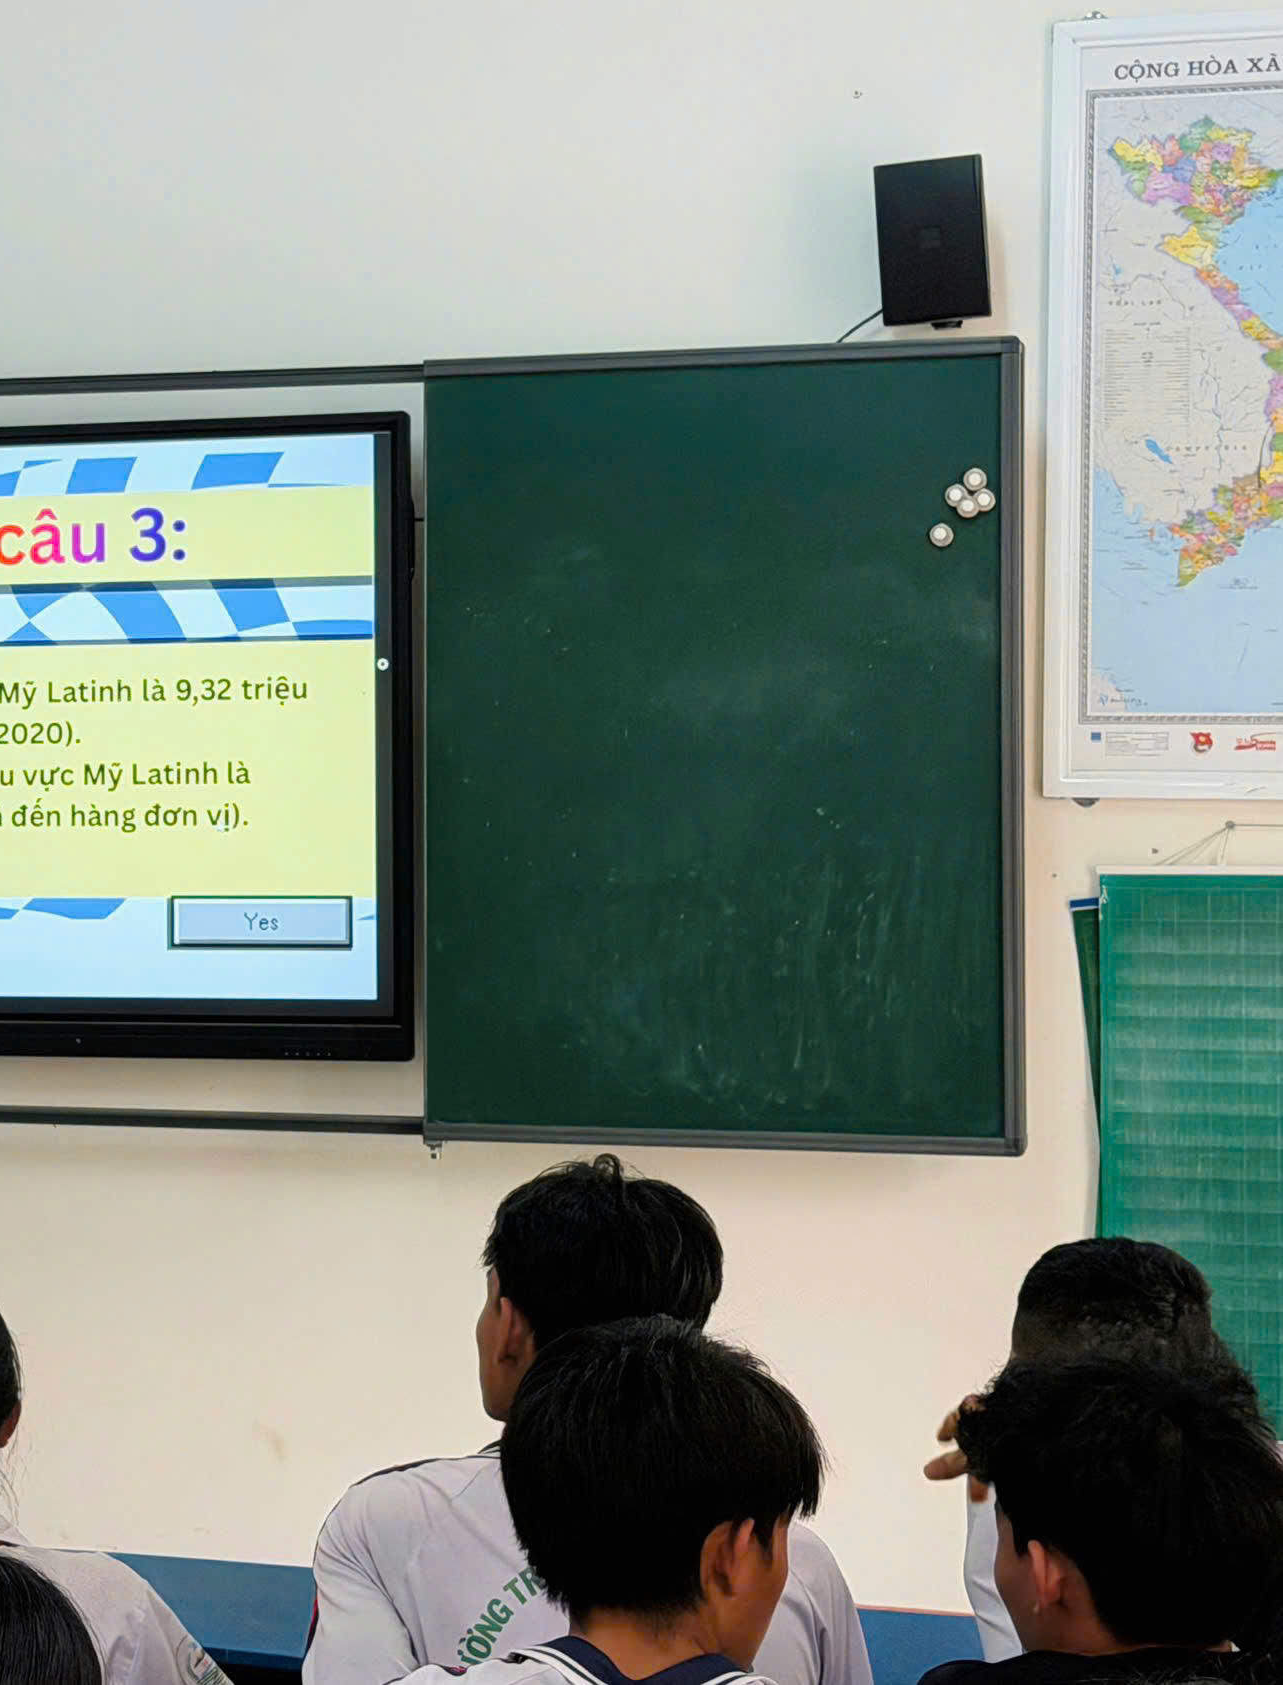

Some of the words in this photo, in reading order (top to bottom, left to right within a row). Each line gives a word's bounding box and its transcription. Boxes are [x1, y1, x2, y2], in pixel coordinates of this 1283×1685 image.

[1114, 59, 1180, 83] CỘNG
[1187, 54, 1239, 76] HÒA
[129, 507, 186, 563] 3:
[48, 679, 132, 703] Latinh
[143, 678, 166, 702] là
[176, 679, 231, 706] 9,32
[242, 676, 307, 706] triệu
[23, 766, 74, 792] vực
[84, 762, 123, 792] Mỹ
[133, 761, 218, 785] Latinh
[228, 761, 251, 785] là
[12, 798, 61, 827] đến
[71, 803, 136, 833] hàng
[145, 803, 197, 826] đơn
[207, 802, 249, 832] vị).
[243, 911, 279, 931] Yes
